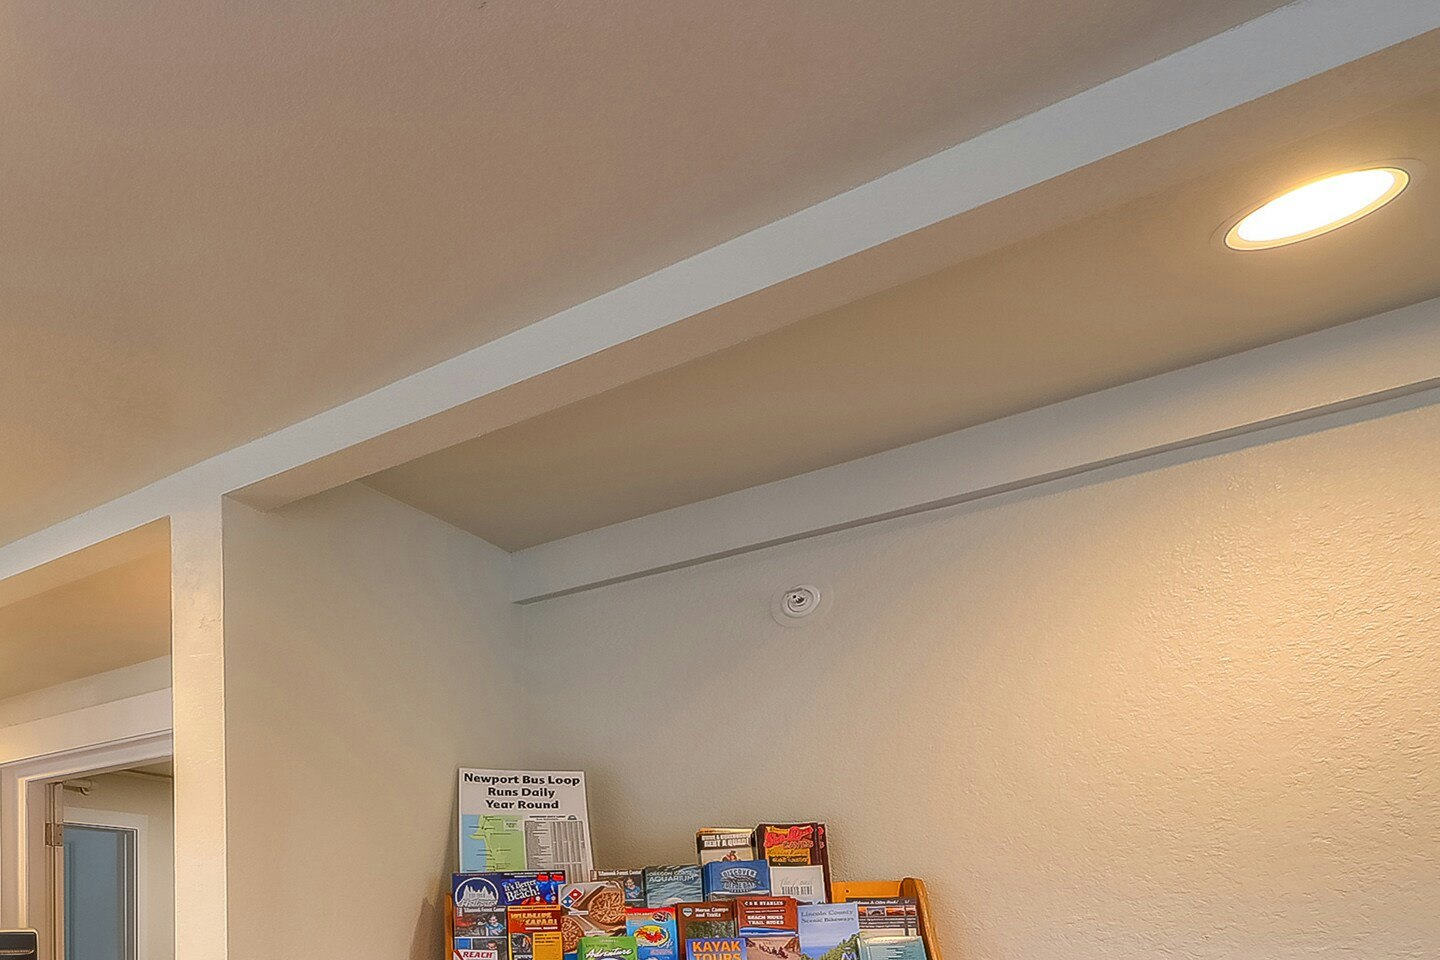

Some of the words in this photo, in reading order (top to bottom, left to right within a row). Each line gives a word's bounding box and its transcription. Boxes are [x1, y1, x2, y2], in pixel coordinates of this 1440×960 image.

[464, 773, 520, 786] Newport
[522, 775, 545, 785] Bus
[548, 776, 581, 786] Loop
[488, 787, 519, 797] Runs
[521, 788, 555, 799] Daily
[485, 800, 515, 809] Year
[518, 800, 559, 809] Round
[506, 885, 541, 902] Beach!
[524, 918, 558, 926] SAFARI
[692, 941, 741, 952] KAYAK
[586, 947, 633, 959] Adventure
